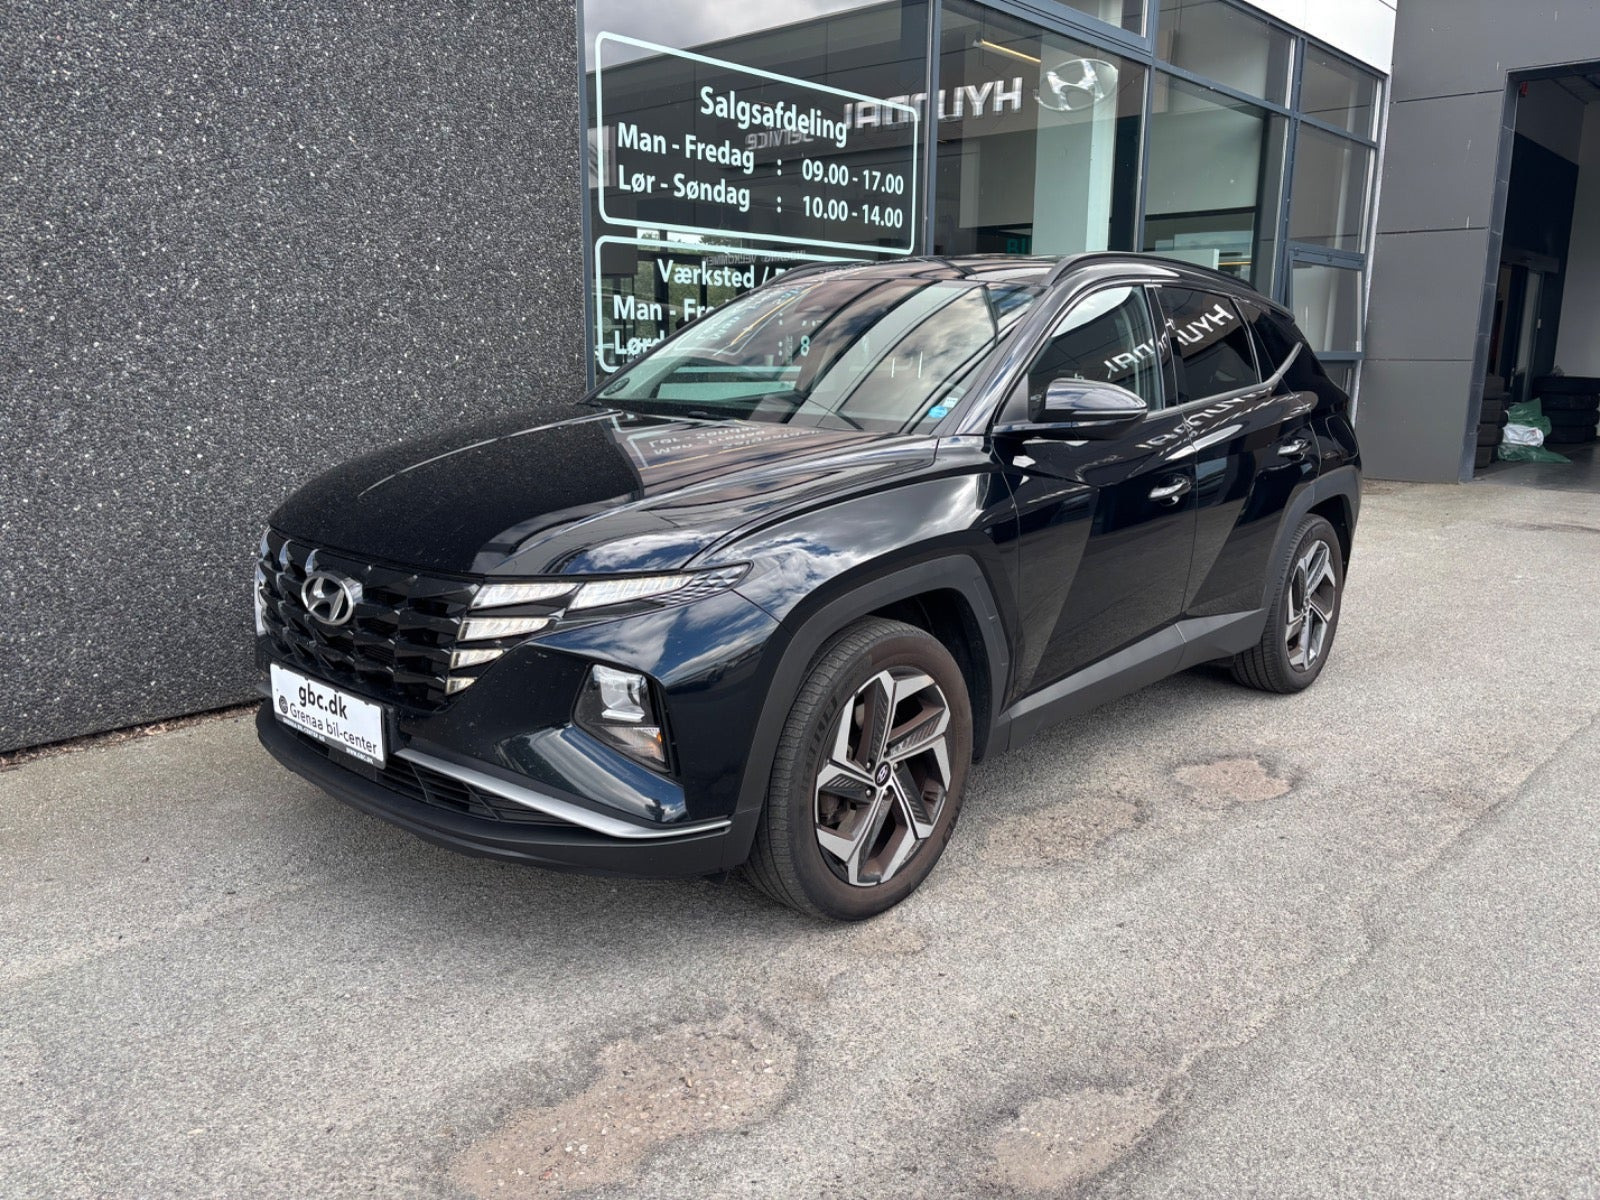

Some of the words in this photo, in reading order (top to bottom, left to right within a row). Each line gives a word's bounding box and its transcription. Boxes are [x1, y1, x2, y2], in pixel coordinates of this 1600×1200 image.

[700, 86, 851, 148] Salgsafdeling
[618, 122, 666, 154] Man
[685, 134, 754, 175] Fredag
[802, 158, 849, 186] 09.00
[863, 169, 904, 195] 17.00
[619, 164, 656, 193] Lør
[673, 173, 750, 212] Søndag
[803, 195, 849, 222] 10.00
[862, 204, 903, 228] 14.00
[657, 258, 755, 288] Værksted
[613, 294, 662, 321] Man
[299, 682, 348, 720] gbc.dk
[290, 702, 324, 731] Grenaa
[326, 717, 377, 754] bil-center
